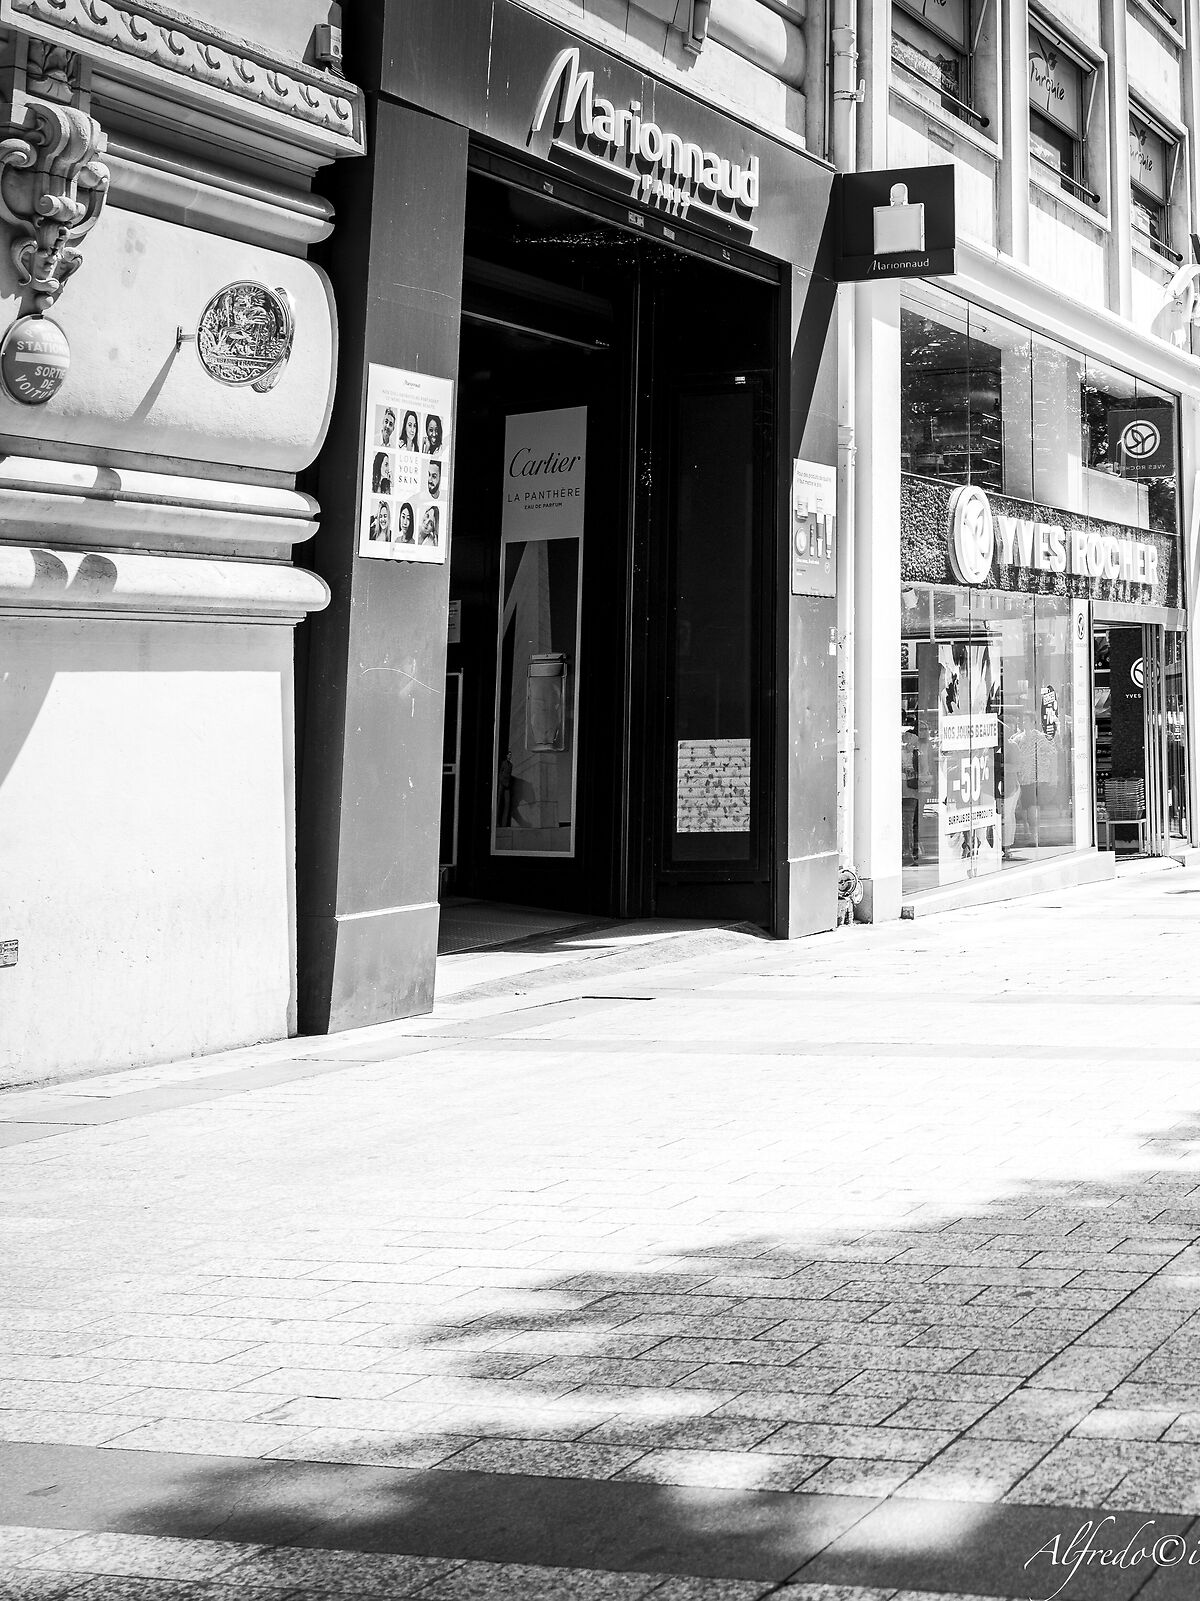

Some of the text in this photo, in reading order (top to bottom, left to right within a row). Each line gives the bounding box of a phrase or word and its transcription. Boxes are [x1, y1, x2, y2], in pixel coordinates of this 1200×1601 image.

[532, 48, 760, 208] Marionnaud
[641, 174, 691, 207] PARIS
[867, 258, 930, 275] Marionnaud
[40, 379, 55, 390] DE
[509, 447, 581, 478] Cartier
[507, 487, 581, 503] LA PANTHÈRE
[997, 515, 1159, 585] YVES ROCHER
[953, 756, 989, 803] -50%
